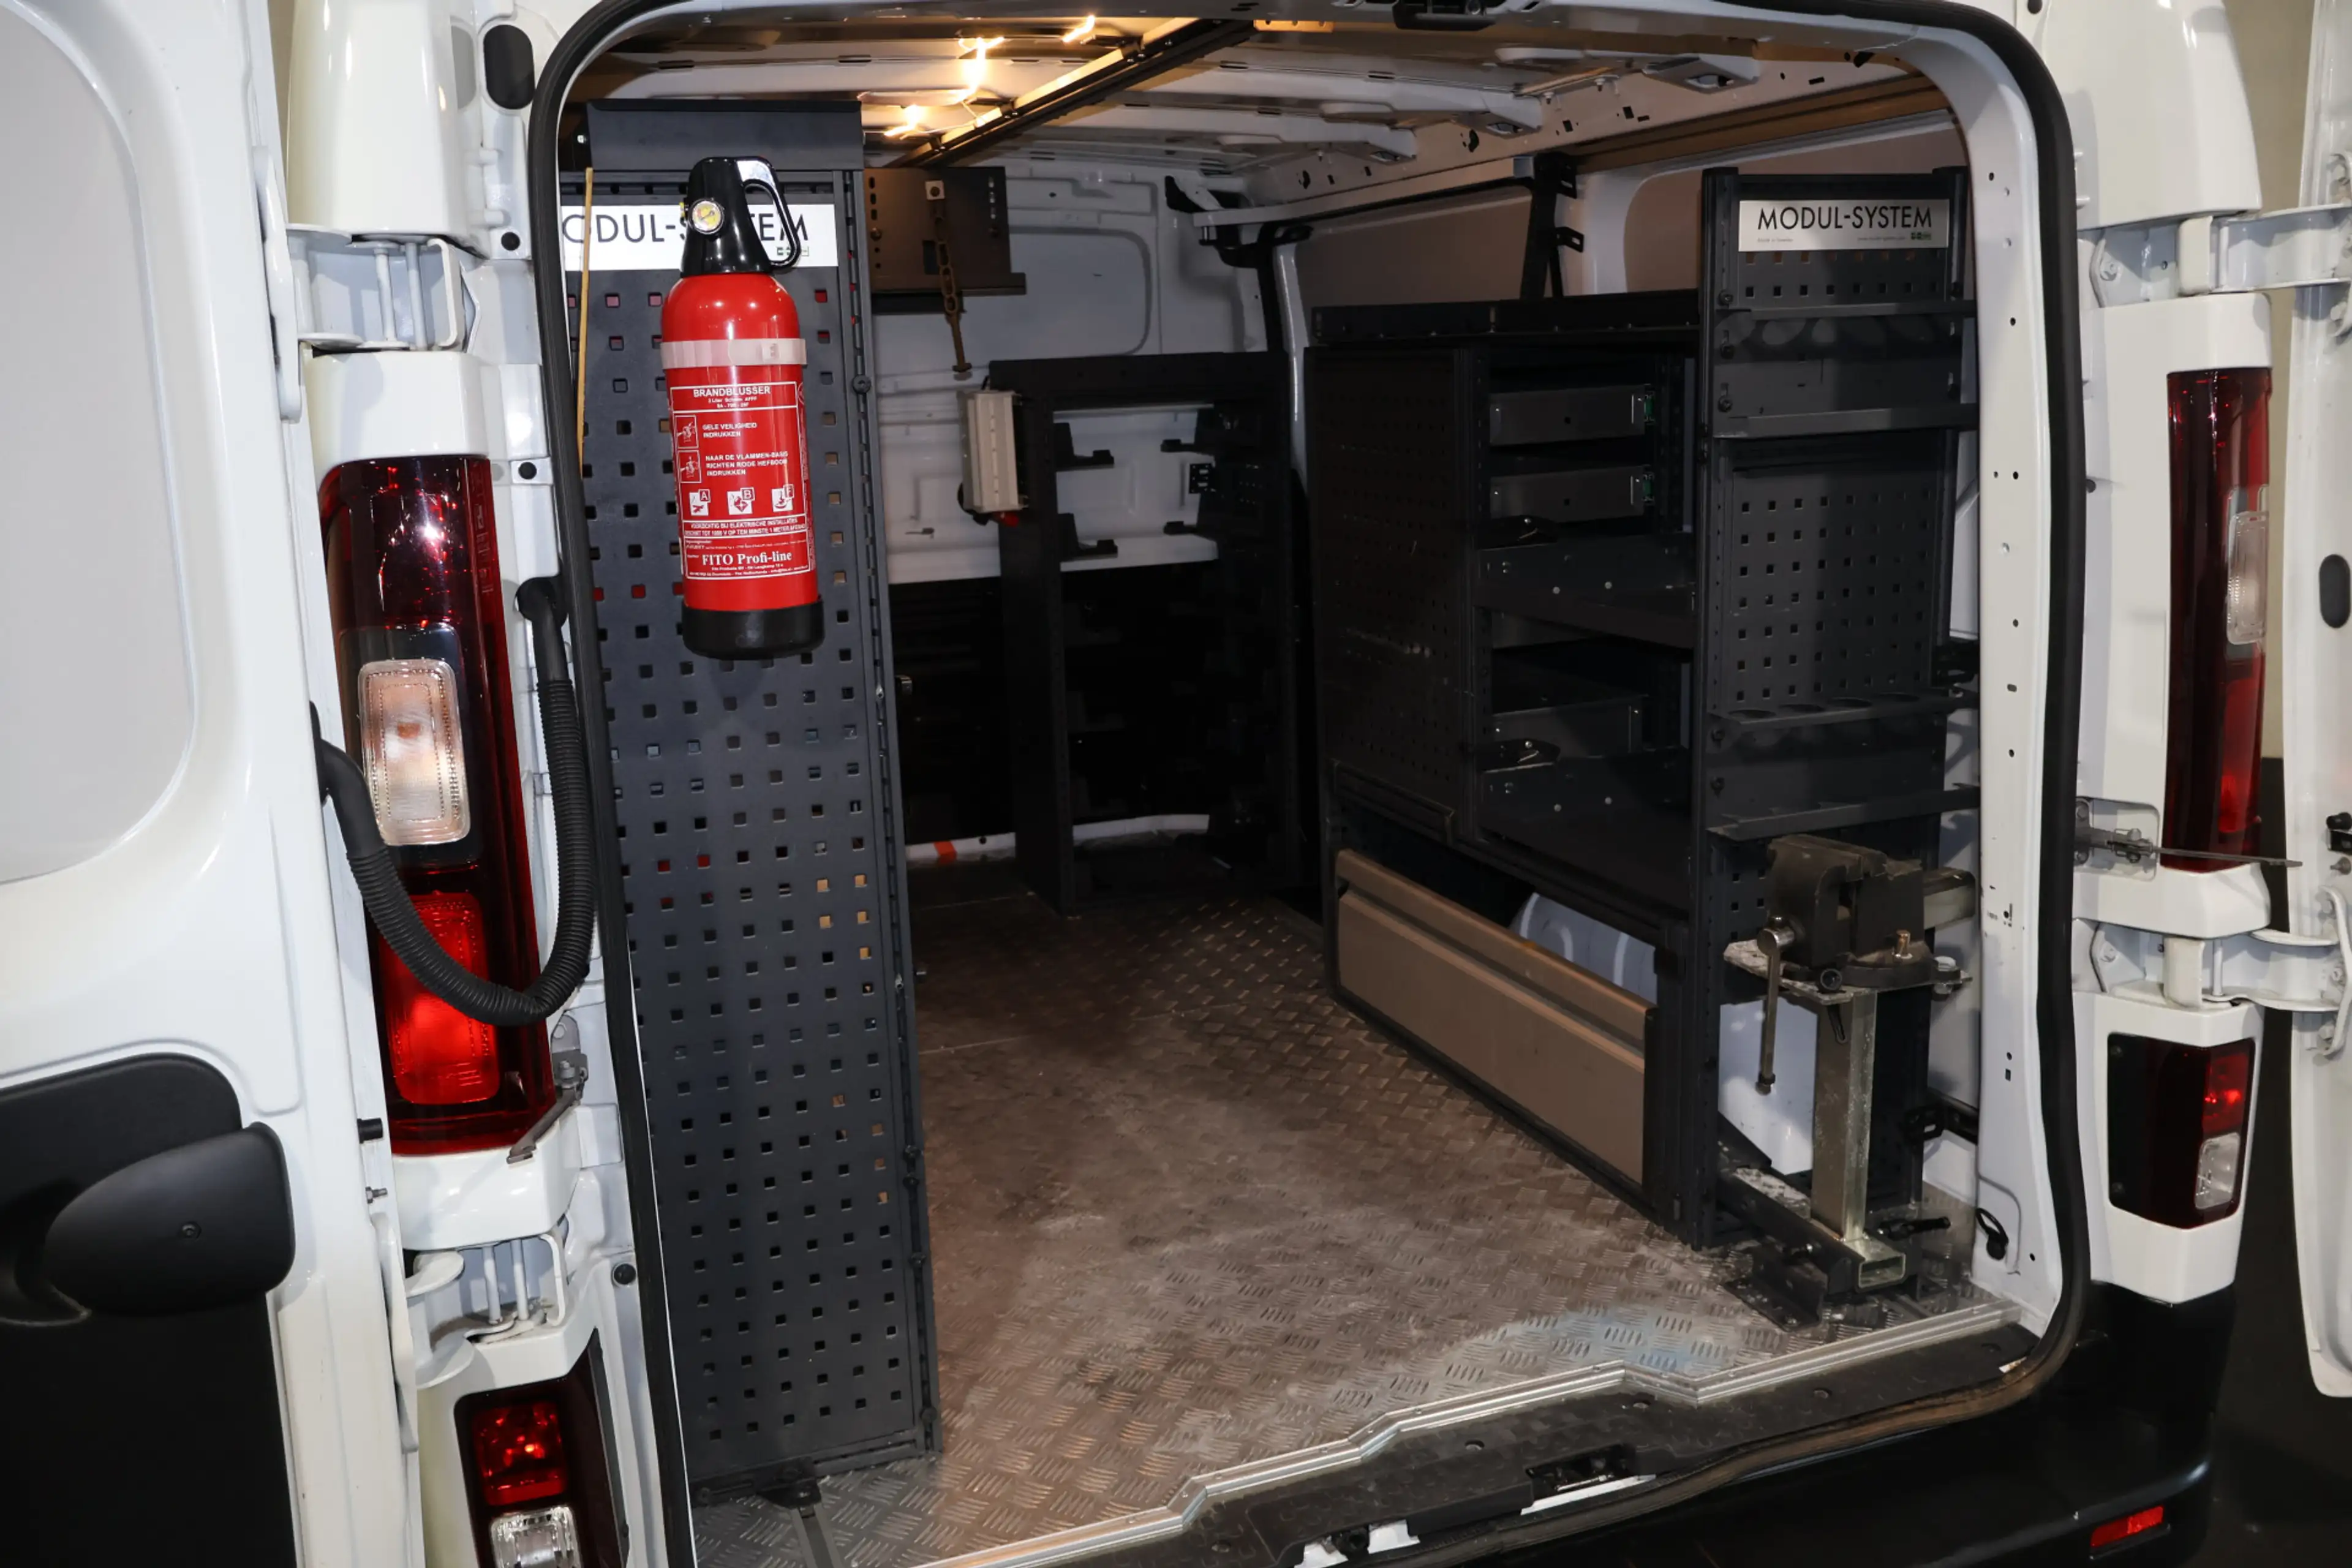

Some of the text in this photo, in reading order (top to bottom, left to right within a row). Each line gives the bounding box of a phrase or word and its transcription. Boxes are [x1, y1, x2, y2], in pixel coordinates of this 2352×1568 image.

[1757, 206, 1932, 230] MODUL-SYSTEM
[693, 386, 771, 398] BRANDBLUSSER
[700, 492, 708, 501] A
[702, 551, 792, 566] FITO Profi-line
